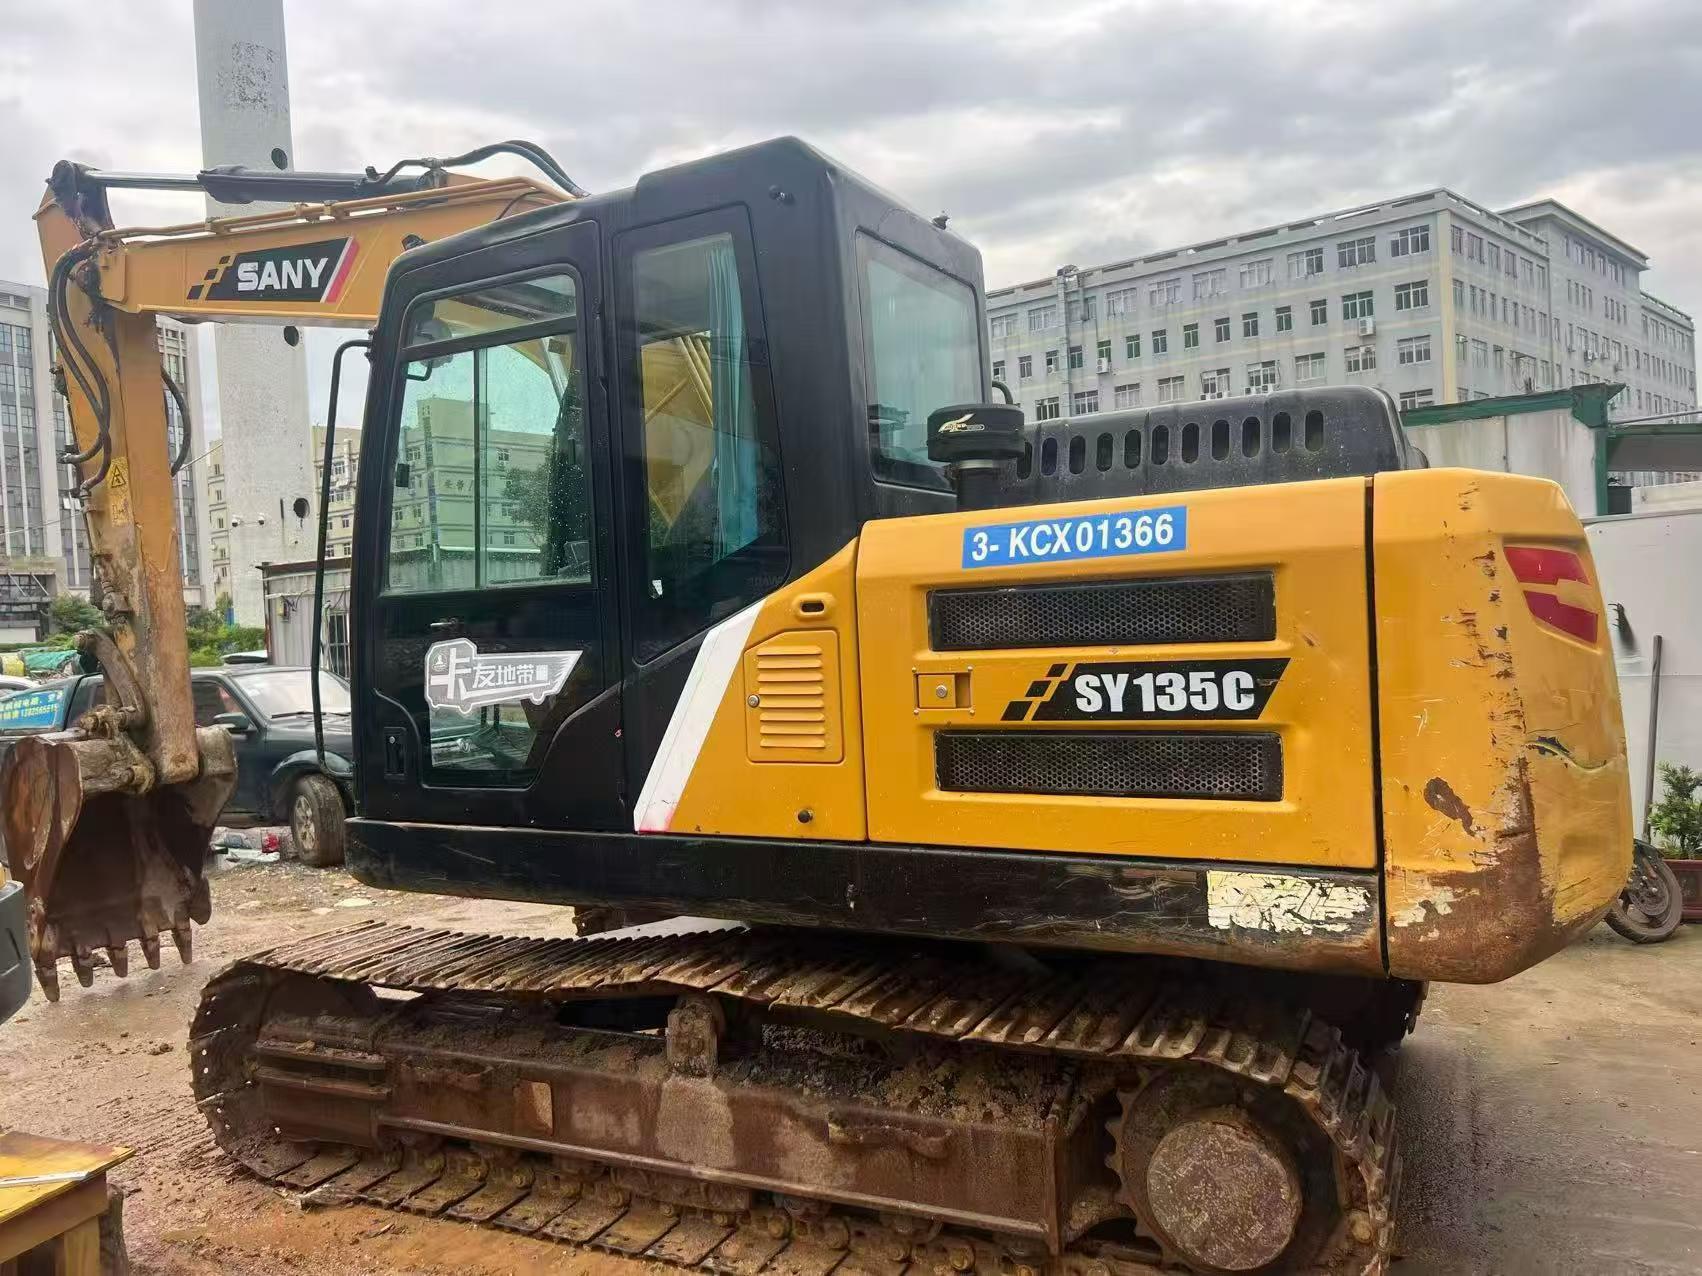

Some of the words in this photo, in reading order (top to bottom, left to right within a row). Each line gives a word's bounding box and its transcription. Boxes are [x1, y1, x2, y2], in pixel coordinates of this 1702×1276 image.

[237, 257, 329, 291] SANY
[971, 531, 999, 561] 3-
[1008, 513, 1174, 558] KCX01366
[430, 647, 549, 701] 卡友地带
[1074, 670, 1255, 712] SY135C
